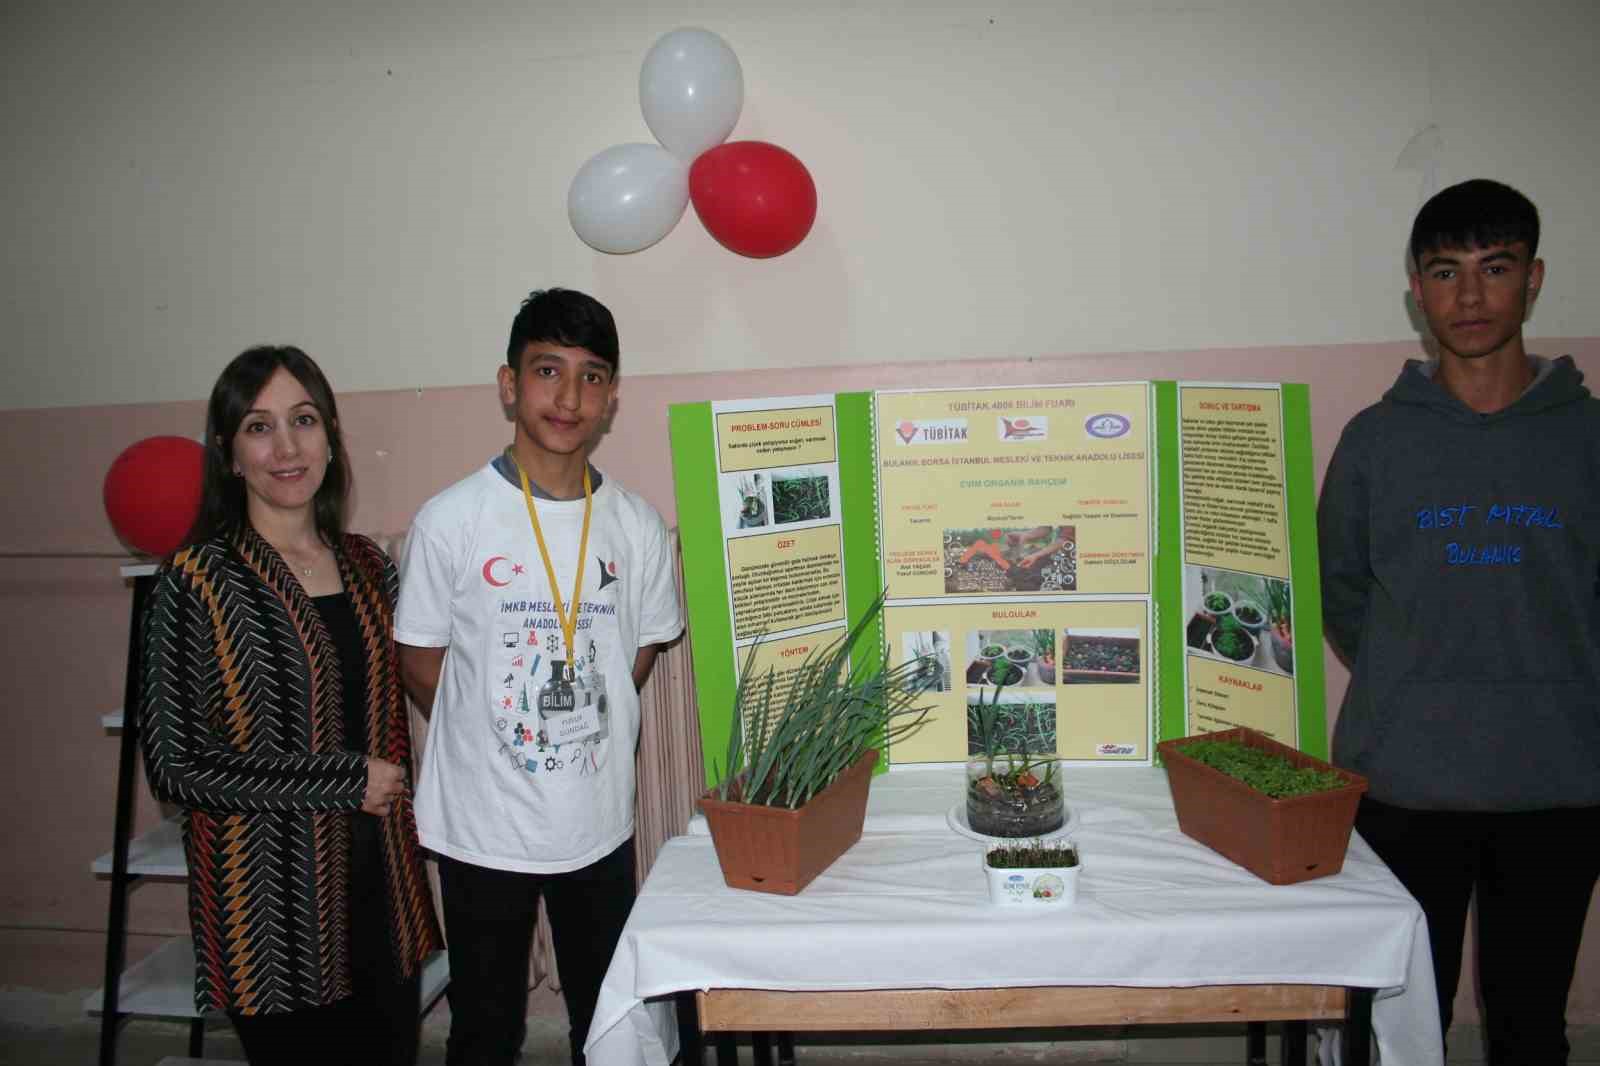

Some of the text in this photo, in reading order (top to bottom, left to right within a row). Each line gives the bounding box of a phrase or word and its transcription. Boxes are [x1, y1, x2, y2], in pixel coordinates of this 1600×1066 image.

[731, 416, 822, 432] PROBLEM-SORU CÜMLESİ
[924, 426, 968, 441] TÜBİTAK
[777, 539, 796, 550] ÖZET
[500, 601, 527, 613] İMKB
[1218, 675, 1264, 692] KAYNAKLAR
[543, 692, 573, 707] BİLİM
